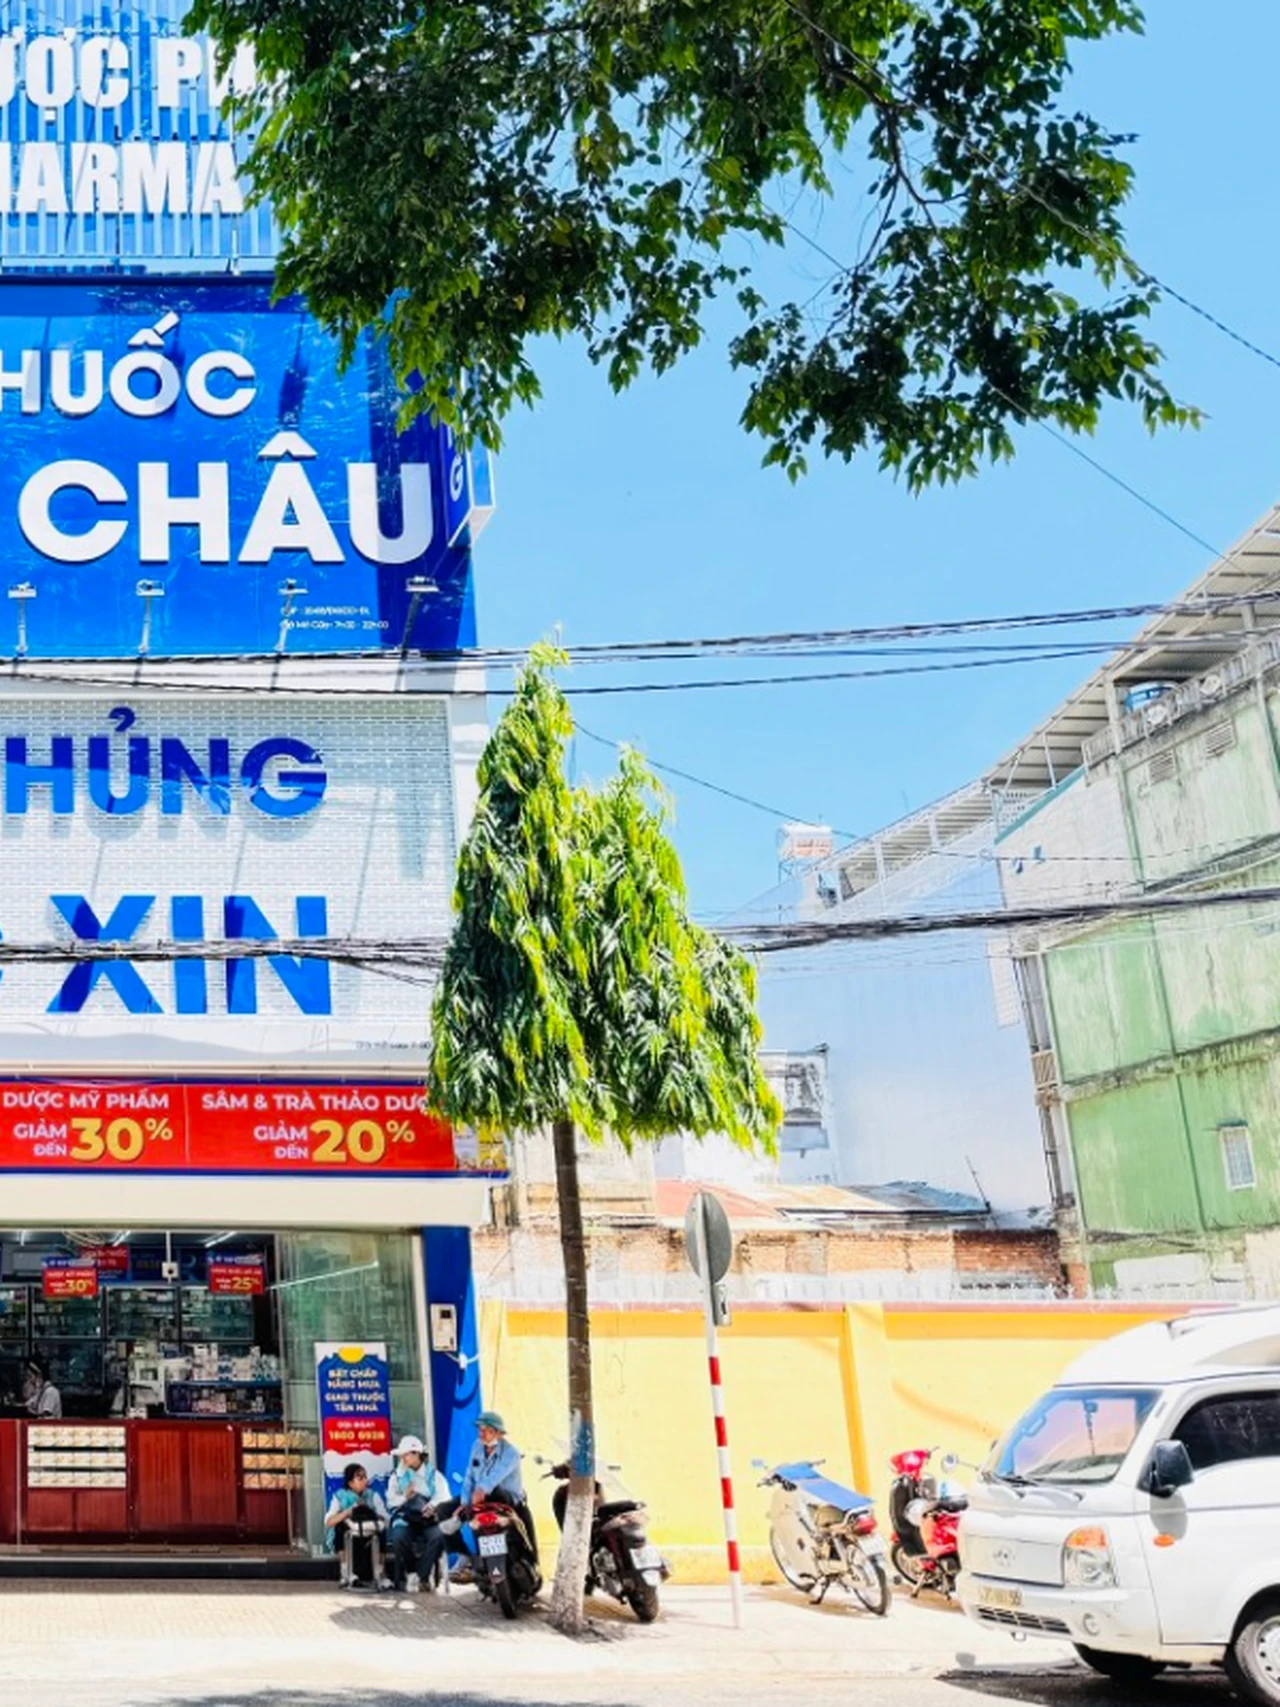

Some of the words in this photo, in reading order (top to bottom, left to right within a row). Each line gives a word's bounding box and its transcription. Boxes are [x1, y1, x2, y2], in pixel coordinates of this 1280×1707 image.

[157, 37, 260, 107] PH
[17, 430, 435, 564] CHÂU
[46, 895, 334, 1016] XIN
[3, 1090, 65, 1112] DƯỢC
[69, 1089, 102, 1110] MỸ
[106, 1087, 169, 1110] PHẨM
[202, 1089, 251, 1111] SÂM
[254, 1094, 269, 1111] &
[273, 1089, 315, 1111] TRÀ
[320, 1089, 379, 1111] THẢO
[14, 1121, 67, 1140] GIẢM
[69, 1117, 173, 1162] 30%
[254, 1123, 308, 1141] GIẢM
[310, 1119, 416, 1163] 20%
[34, 1139, 67, 1156] ĐẾN
[275, 1142, 309, 1159] ĐẾN
